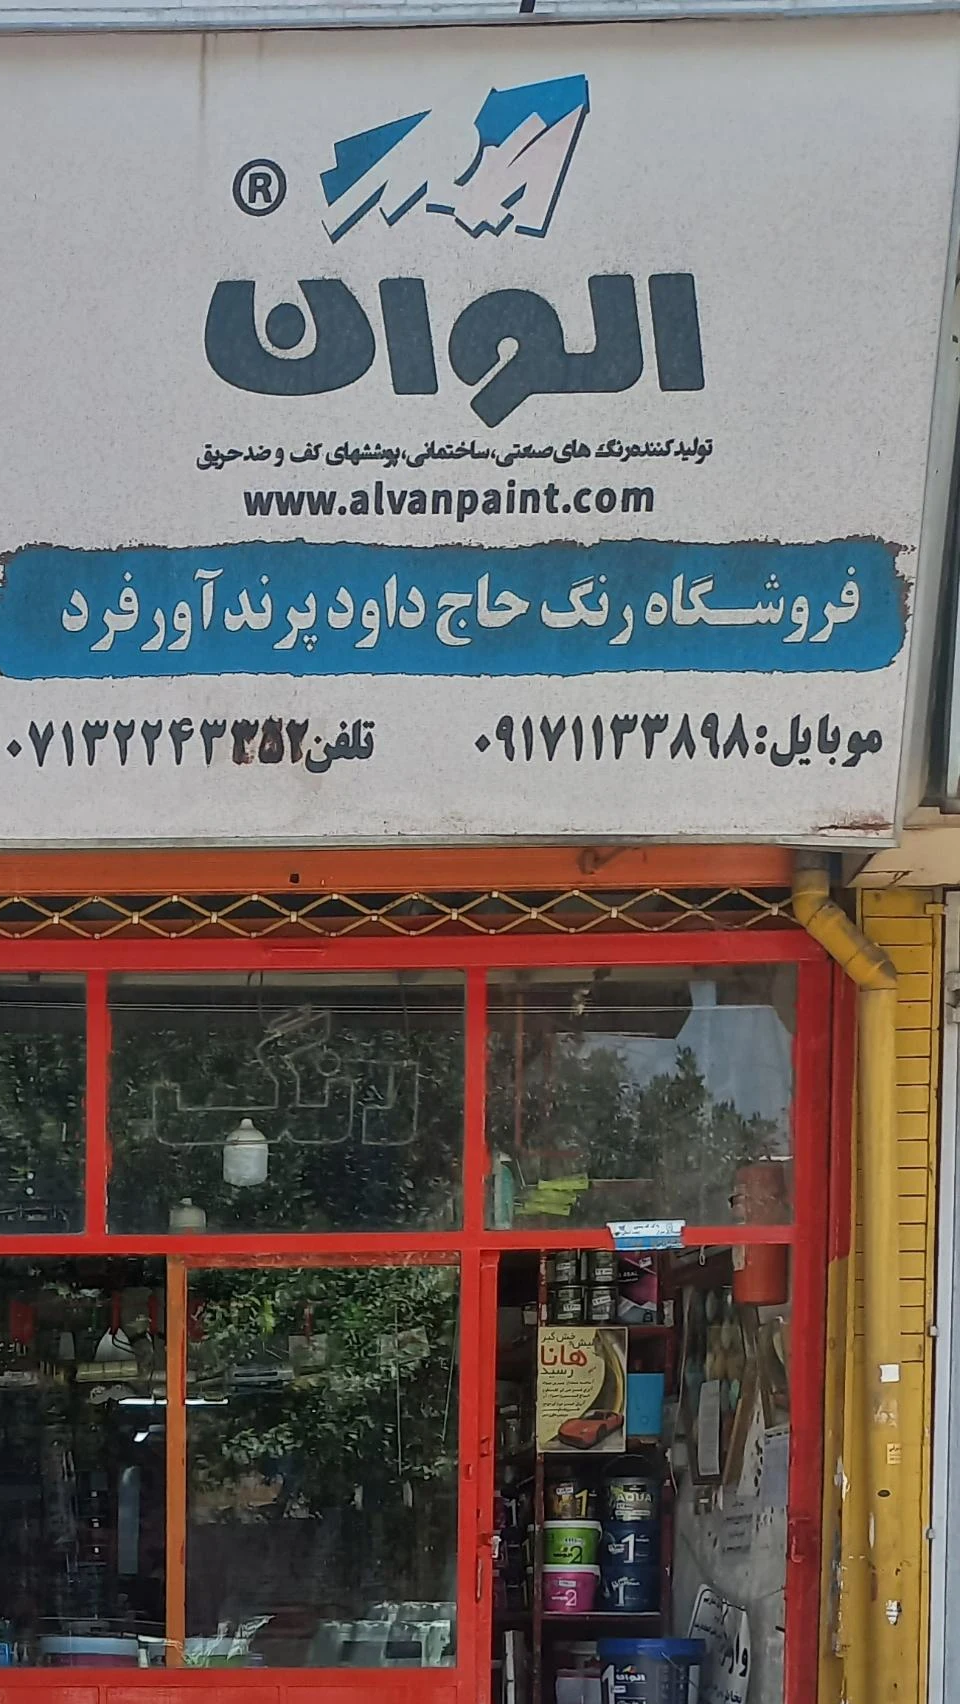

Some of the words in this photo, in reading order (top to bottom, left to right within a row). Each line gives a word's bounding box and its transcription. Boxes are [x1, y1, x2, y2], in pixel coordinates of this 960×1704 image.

[204, 272, 706, 428] الوان
[274, 448, 285, 465] و
[289, 442, 322, 463] کف
[595, 439, 640, 463] رنگ
[243, 480, 656, 523] www.alvanpaint.com
[326, 576, 427, 652] داود
[435, 572, 531, 649] حاج
[534, 574, 635, 648] رنگ
[643, 566, 862, 645] فروشگاه
[304, 718, 376, 774] تلفن
[473, 711, 751, 762] ۰۹۱۷۱۱۳۳۸۹۸
[540, 1344, 587, 1367] هانا
[540, 1367, 574, 1379] رسید
